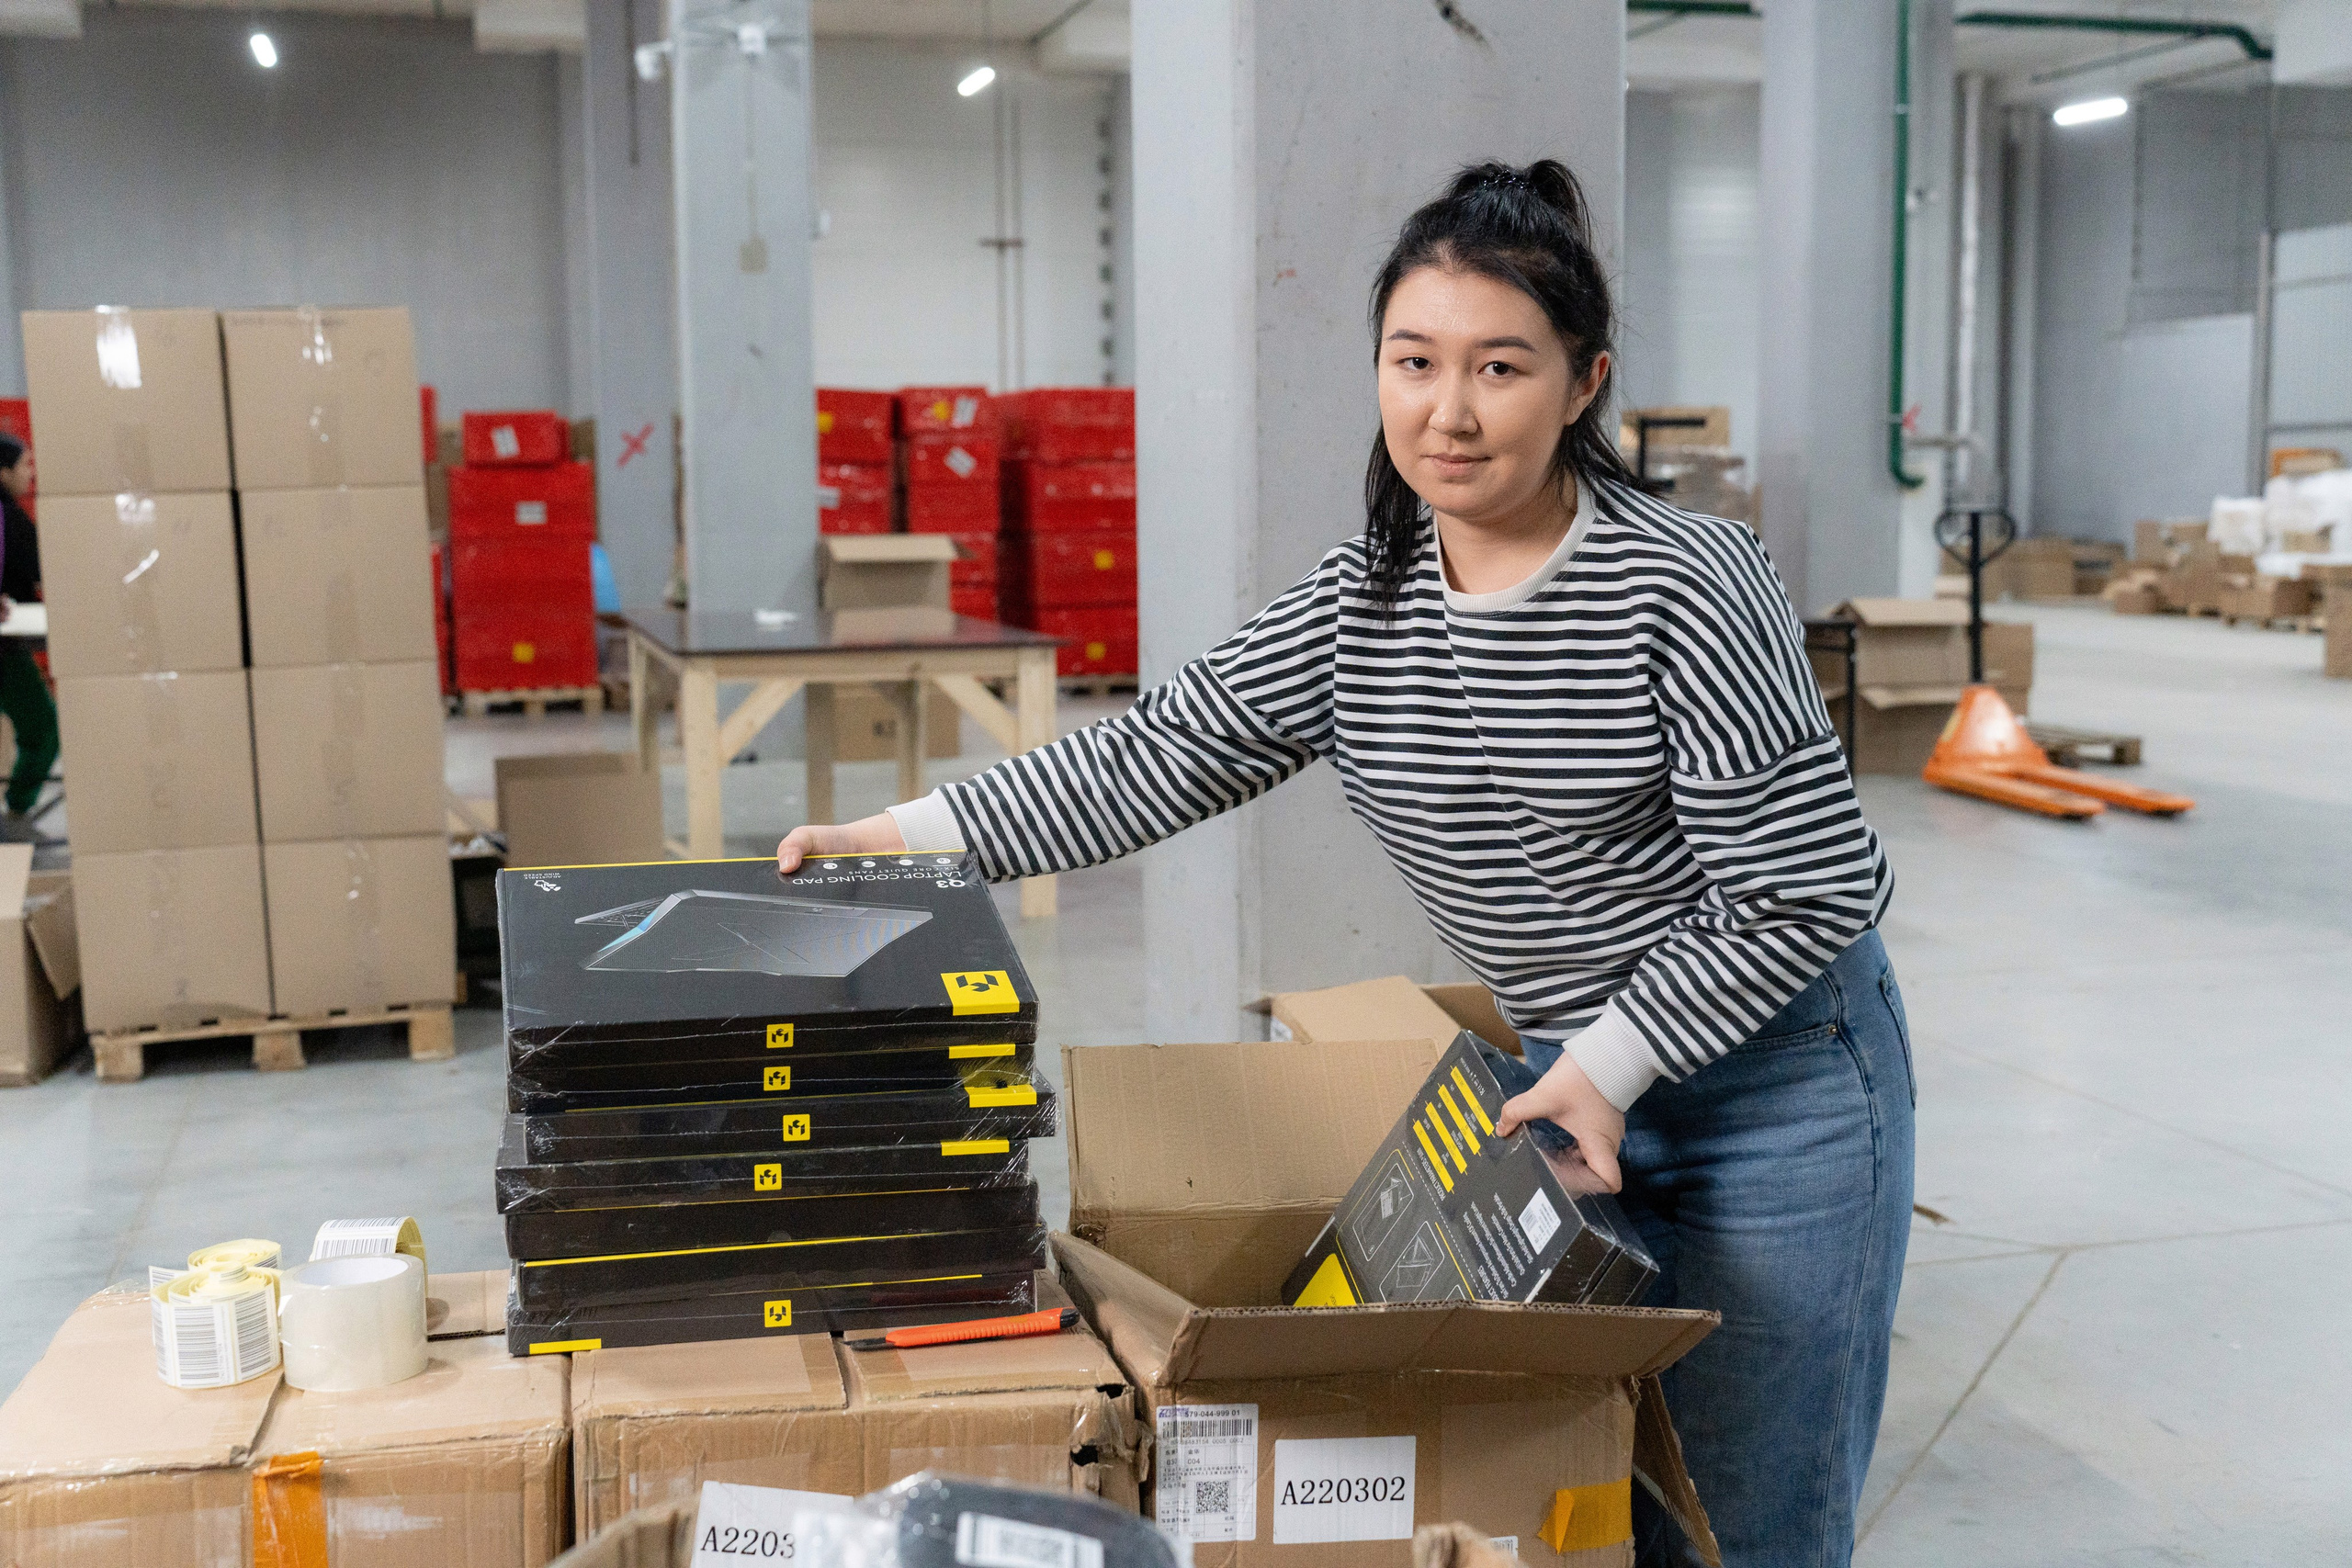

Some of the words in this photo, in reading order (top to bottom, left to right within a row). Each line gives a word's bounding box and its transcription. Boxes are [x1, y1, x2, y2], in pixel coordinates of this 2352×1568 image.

[827, 873, 899, 883] COOLING
[904, 871, 961, 879] LAPTOP
[935, 878, 966, 888] Q3
[1477, 1265, 1491, 1289] FEATURES
[1281, 1476, 1406, 1505] A220302
